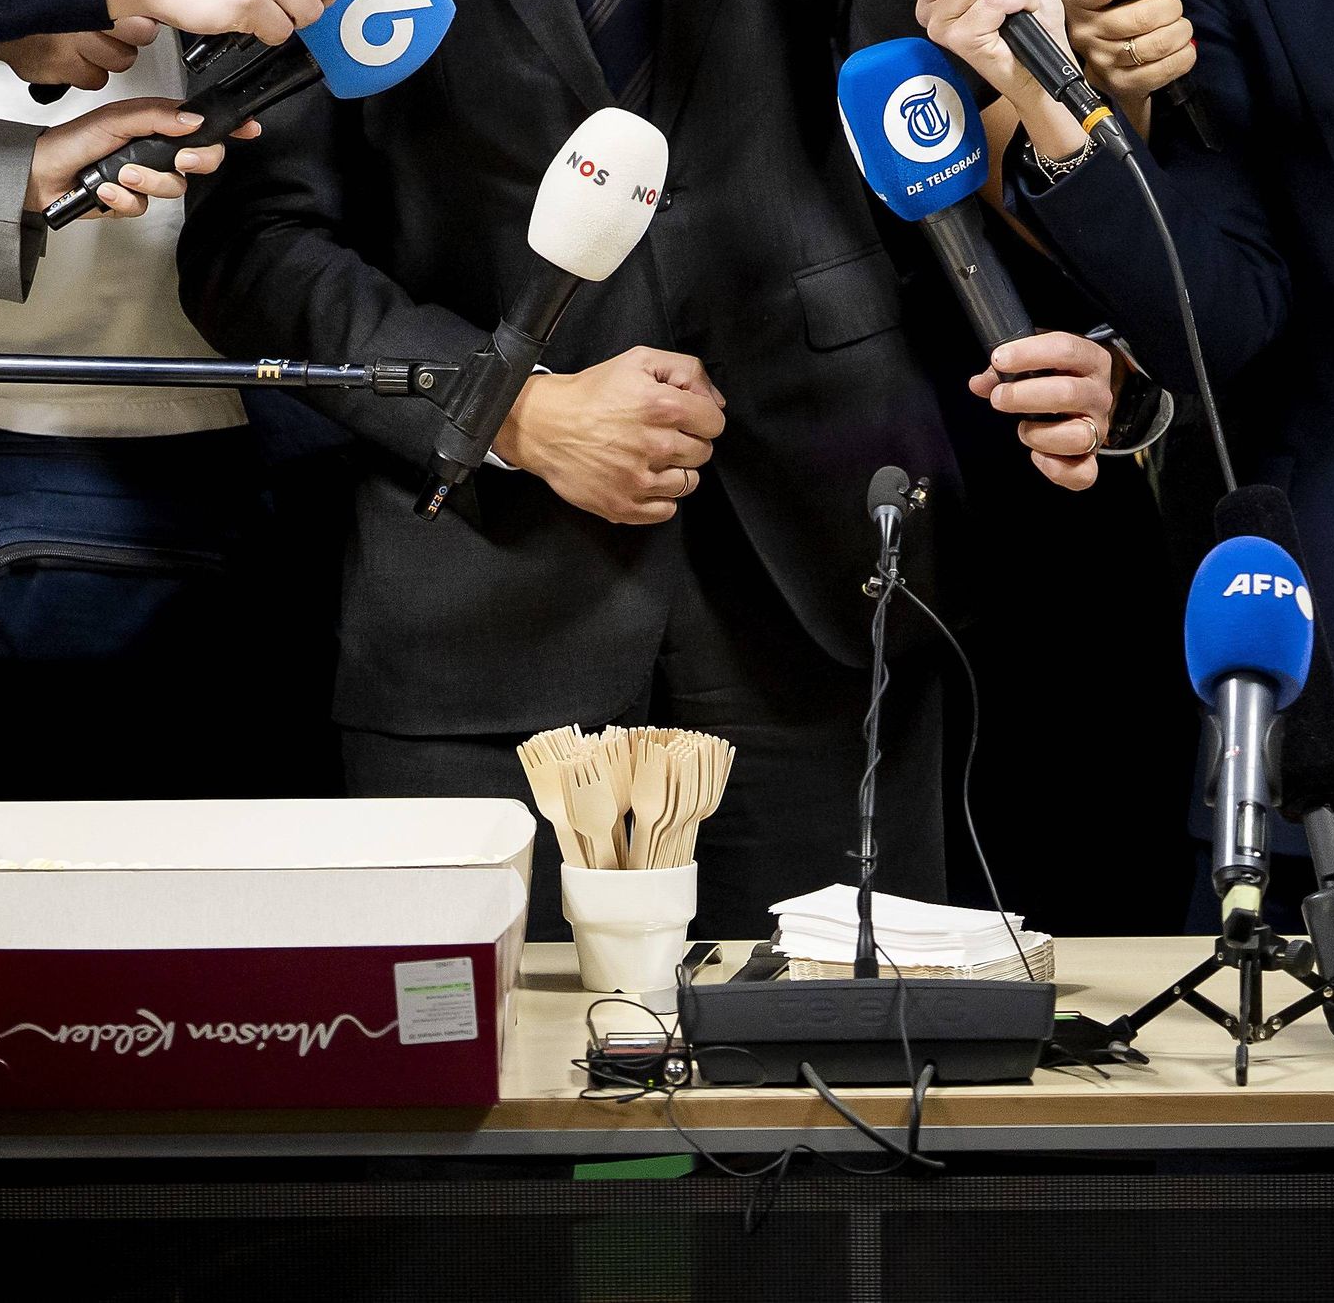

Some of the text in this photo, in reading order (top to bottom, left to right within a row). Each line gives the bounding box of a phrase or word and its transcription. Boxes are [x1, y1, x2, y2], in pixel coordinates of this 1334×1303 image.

[567, 151, 610, 186] NOS
[906, 148, 982, 196] DE TELEGRAAF
[1223, 574, 1294, 598] AFP
[186, 1022, 330, 1057] Maison
